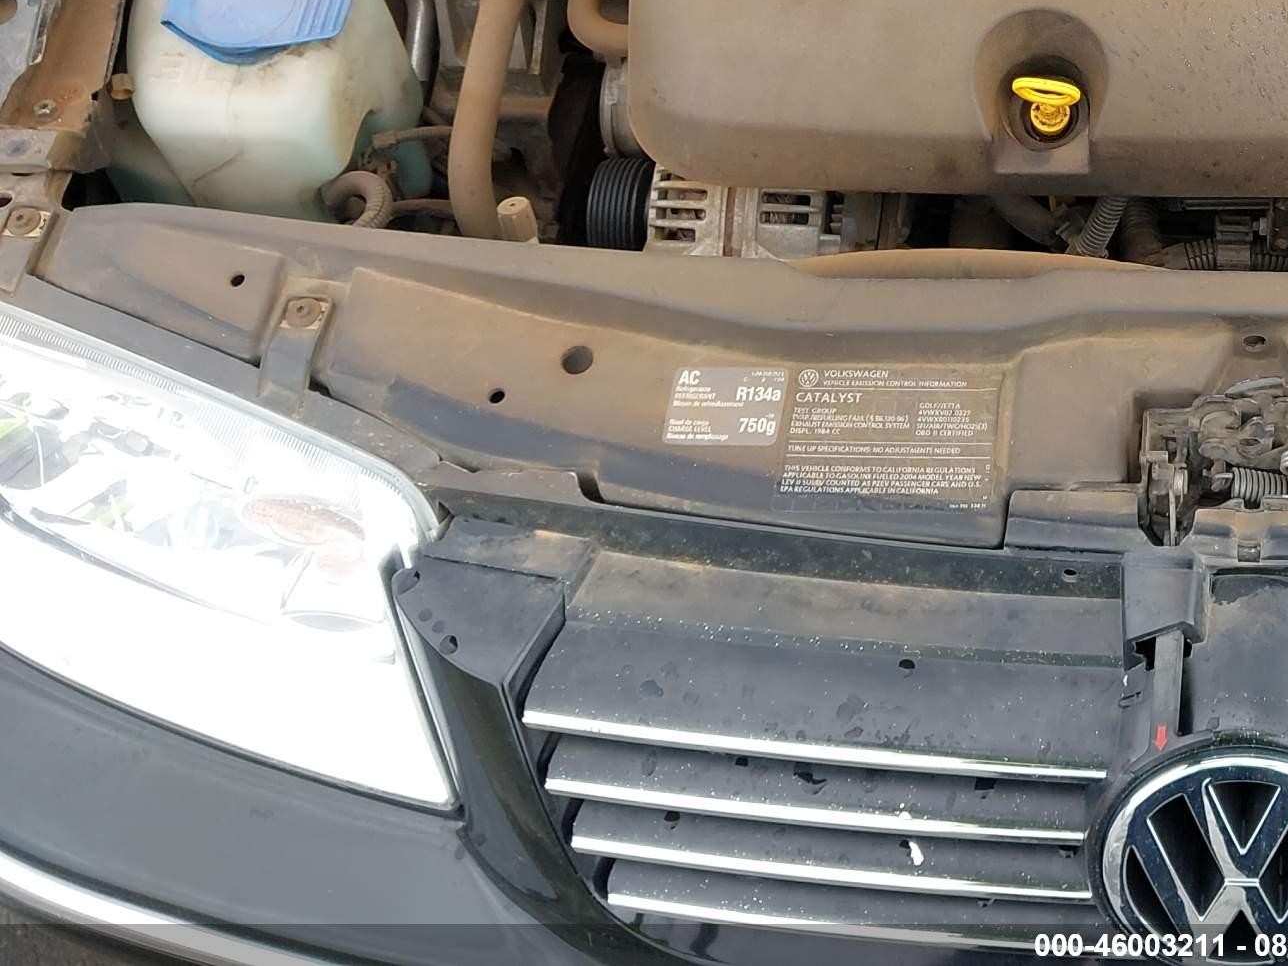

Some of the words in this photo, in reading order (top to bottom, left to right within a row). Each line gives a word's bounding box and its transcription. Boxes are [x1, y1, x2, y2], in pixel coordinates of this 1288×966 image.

[678, 370, 700, 385] AC
[824, 369, 889, 378] VOLKSWAGEN
[736, 386, 782, 402] R134a
[795, 392, 863, 403] CATALYST
[739, 417, 776, 436] 750g
